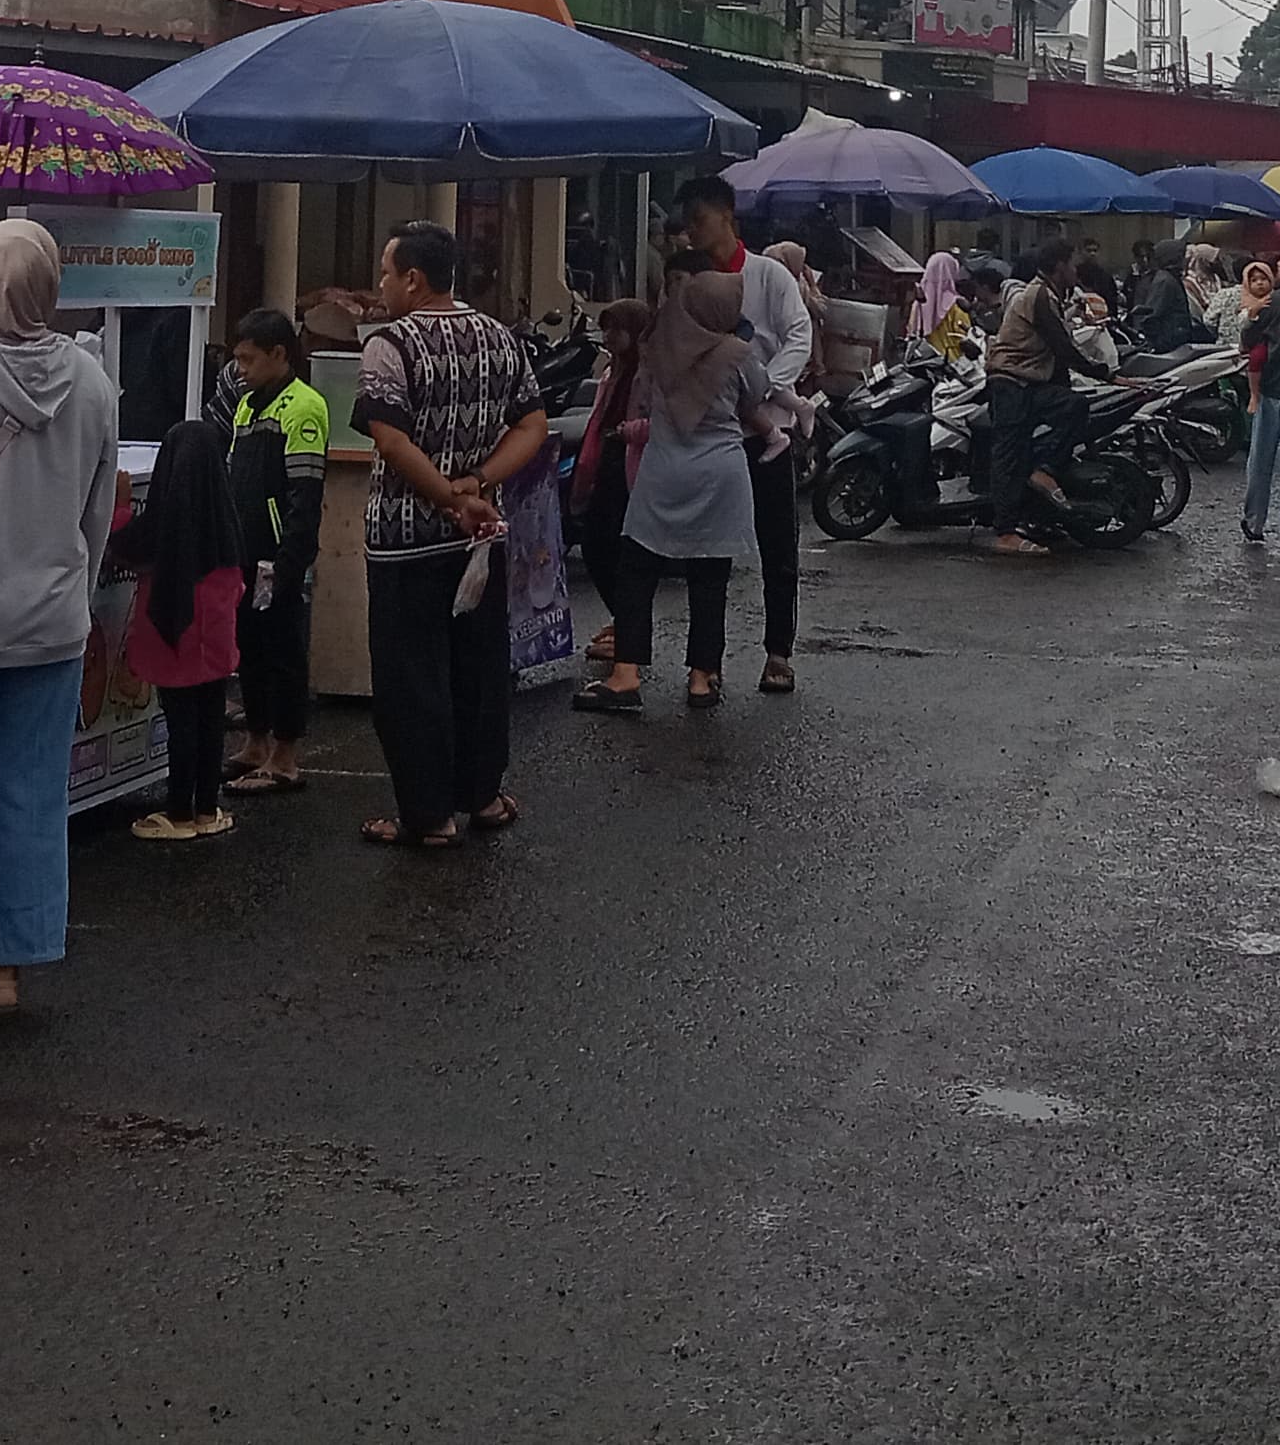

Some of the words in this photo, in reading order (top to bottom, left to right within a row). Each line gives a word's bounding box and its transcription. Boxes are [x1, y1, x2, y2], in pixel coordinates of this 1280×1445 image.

[60, 245, 114, 266] LITTLE
[117, 246, 157, 266] FOOD
[159, 247, 195, 266] KING
